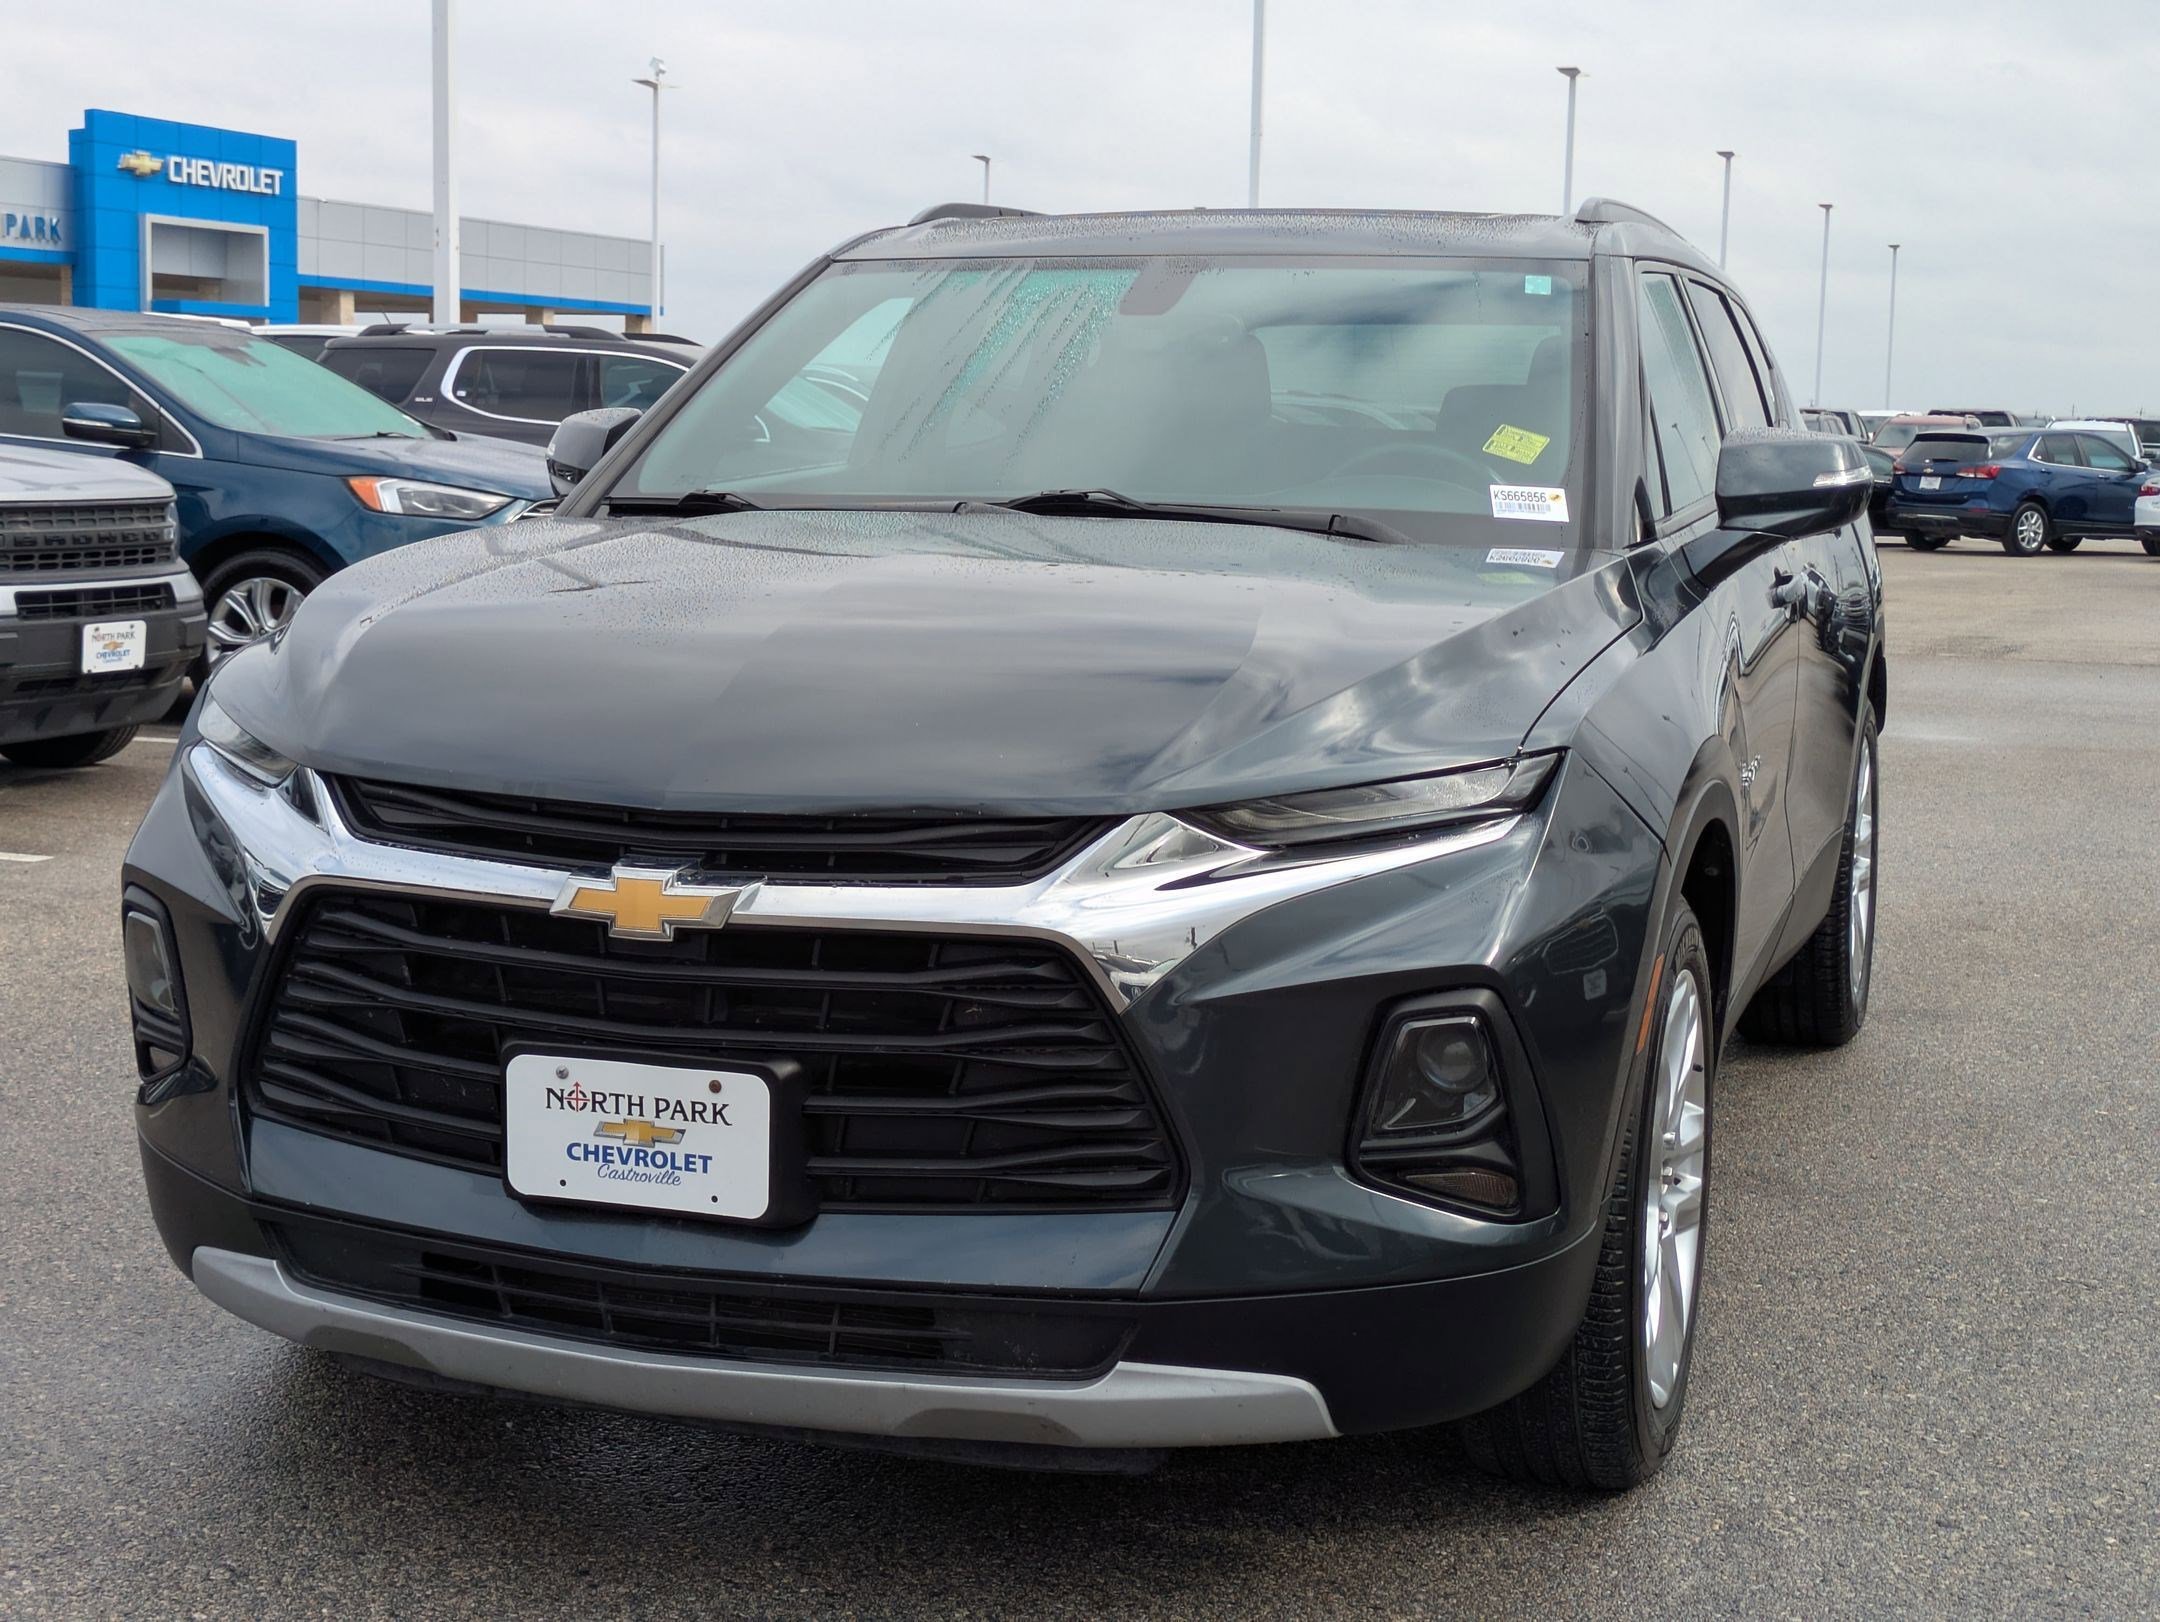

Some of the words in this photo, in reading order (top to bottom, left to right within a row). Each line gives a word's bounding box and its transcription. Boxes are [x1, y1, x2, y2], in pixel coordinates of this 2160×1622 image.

[168, 155, 283, 195] CHEVROLET
[5, 213, 62, 243] PARK
[1493, 490, 1547, 503] KS665856
[13, 531, 160, 547] BRONCO
[116, 631, 136, 640] PARK
[96, 649, 131, 659] CHEVROLET
[545, 1084, 645, 1118] NORTH
[654, 1097, 732, 1126] PARK
[566, 1142, 713, 1174] CHEVROLET
[597, 1163, 682, 1187] Castroville
